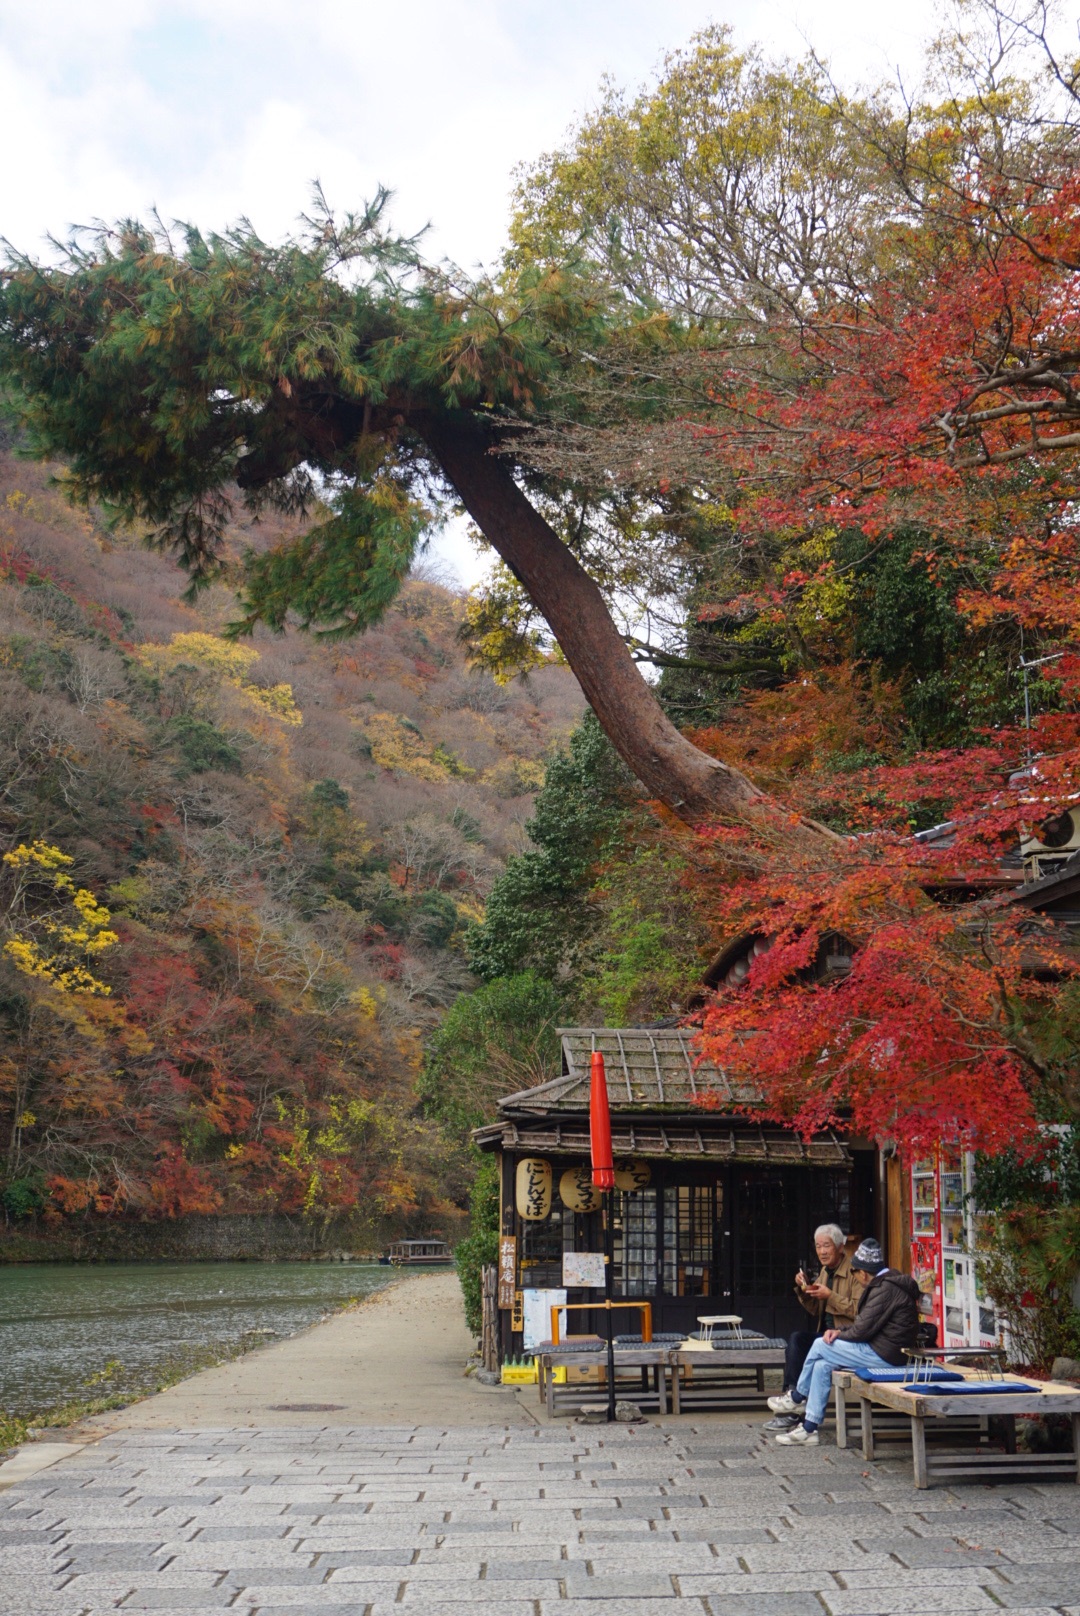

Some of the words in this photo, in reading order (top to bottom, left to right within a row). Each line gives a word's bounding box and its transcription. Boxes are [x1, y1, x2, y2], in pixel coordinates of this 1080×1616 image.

[526, 1163, 547, 1216] にしんそば
